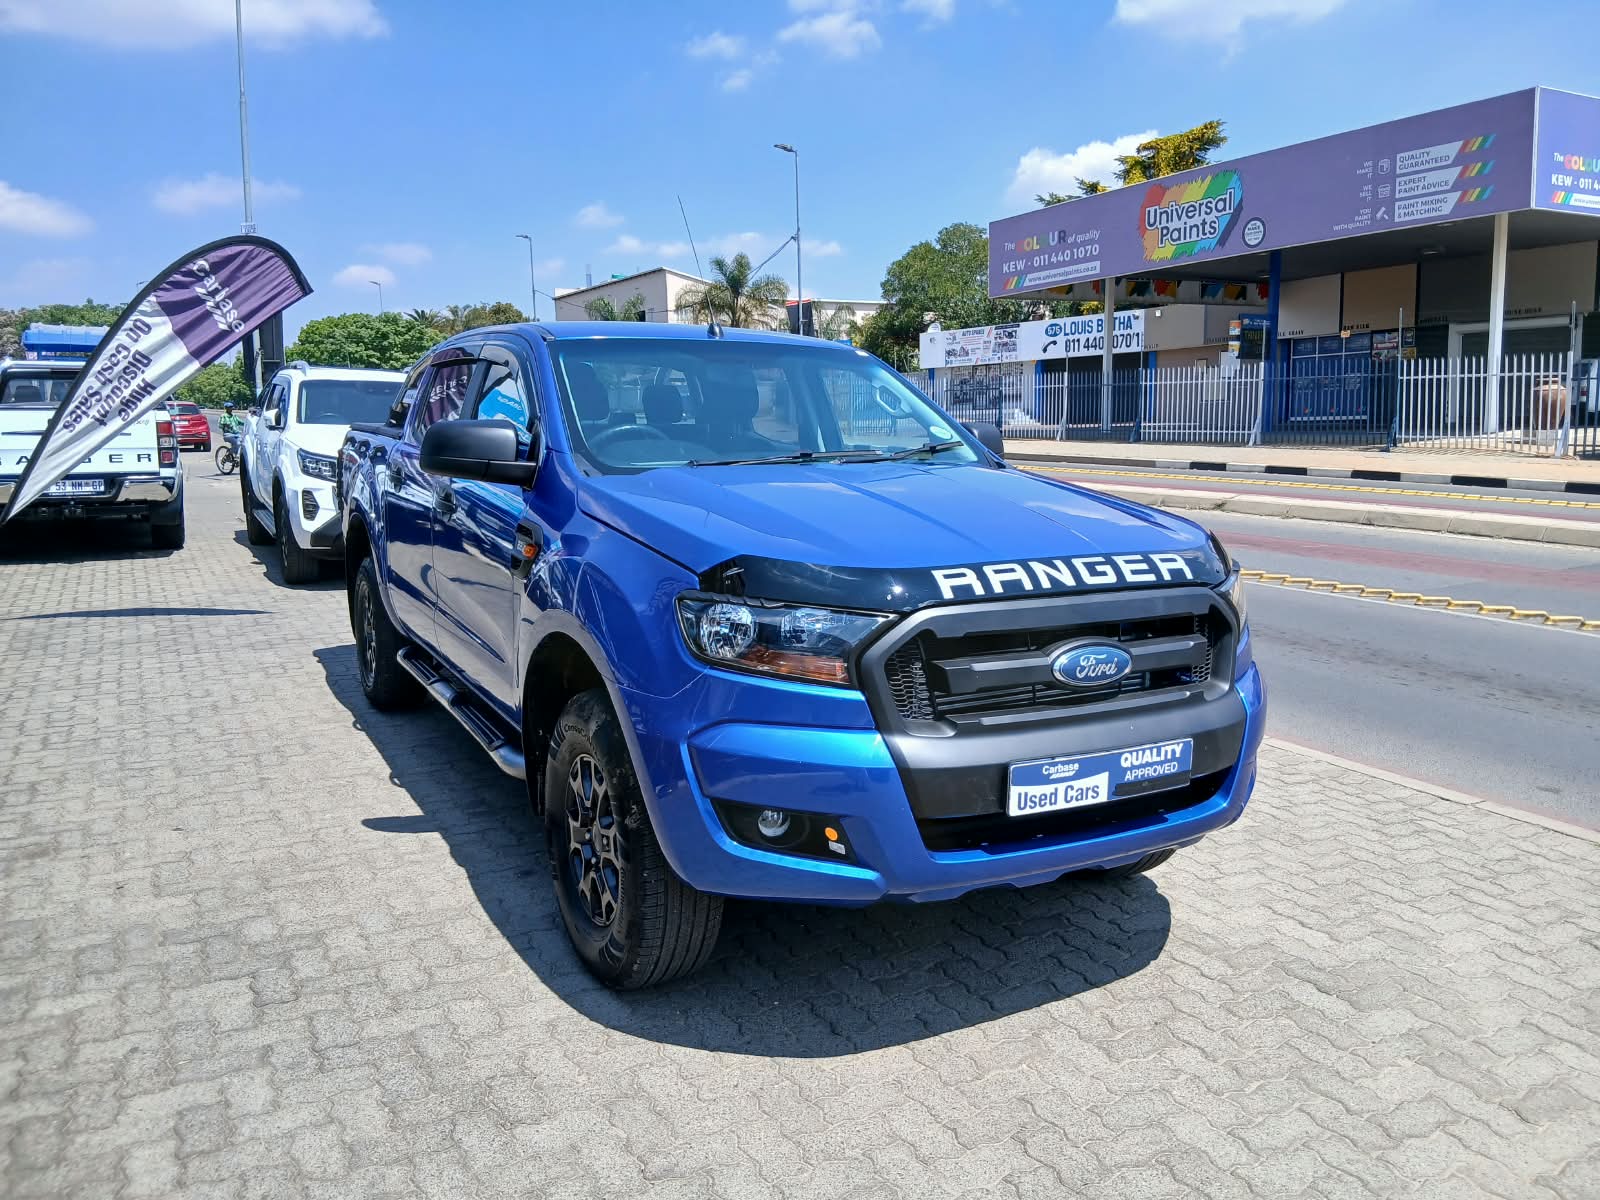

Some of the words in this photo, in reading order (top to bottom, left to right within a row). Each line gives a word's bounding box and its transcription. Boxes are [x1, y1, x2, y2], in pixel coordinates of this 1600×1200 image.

[1399, 151, 1430, 163] QUALITY
[1399, 155, 1450, 170] GUARANTEED
[1553, 152, 1564, 162] The
[1398, 176, 1426, 187] EXPERT
[1398, 185, 1420, 195] PAINT
[1421, 180, 1449, 191] ADVICE
[1551, 174, 1573, 187] KEW
[1579, 178, 1592, 190] 011
[1147, 189, 1234, 229] Universal
[1397, 202, 1419, 211] PAINT
[1421, 197, 1447, 207] MIXING
[1403, 206, 1442, 218] MATCHING
[1004, 242, 1016, 252] The
[1067, 234, 1076, 244] of
[1076, 229, 1101, 244] quality
[1159, 217, 1218, 247] Paints
[1002, 259, 1026, 274] KEW
[1033, 254, 1048, 267] 011
[1050, 250, 1071, 264] 440
[1073, 243, 1100, 259] 1070
[193, 260, 245, 333] Carbase
[125, 317, 152, 344] On
[1063, 320, 1093, 337] LOUIS
[1096, 315, 1133, 334] BTHA
[1065, 338, 1081, 353] 011
[1083, 336, 1104, 352] 440
[94, 342, 131, 386] Cash
[91, 349, 152, 427] Discount
[118, 377, 157, 422] Huge
[62, 384, 103, 433] Sales
[931, 553, 1194, 600] RANGER
[1075, 653, 1118, 679] Ford
[1120, 742, 1184, 768] QUALITY
[1042, 763, 1080, 775] Carbase
[1124, 761, 1178, 782] APPROVED
[1017, 787, 1059, 811] Used
[1063, 784, 1100, 804] Cars
